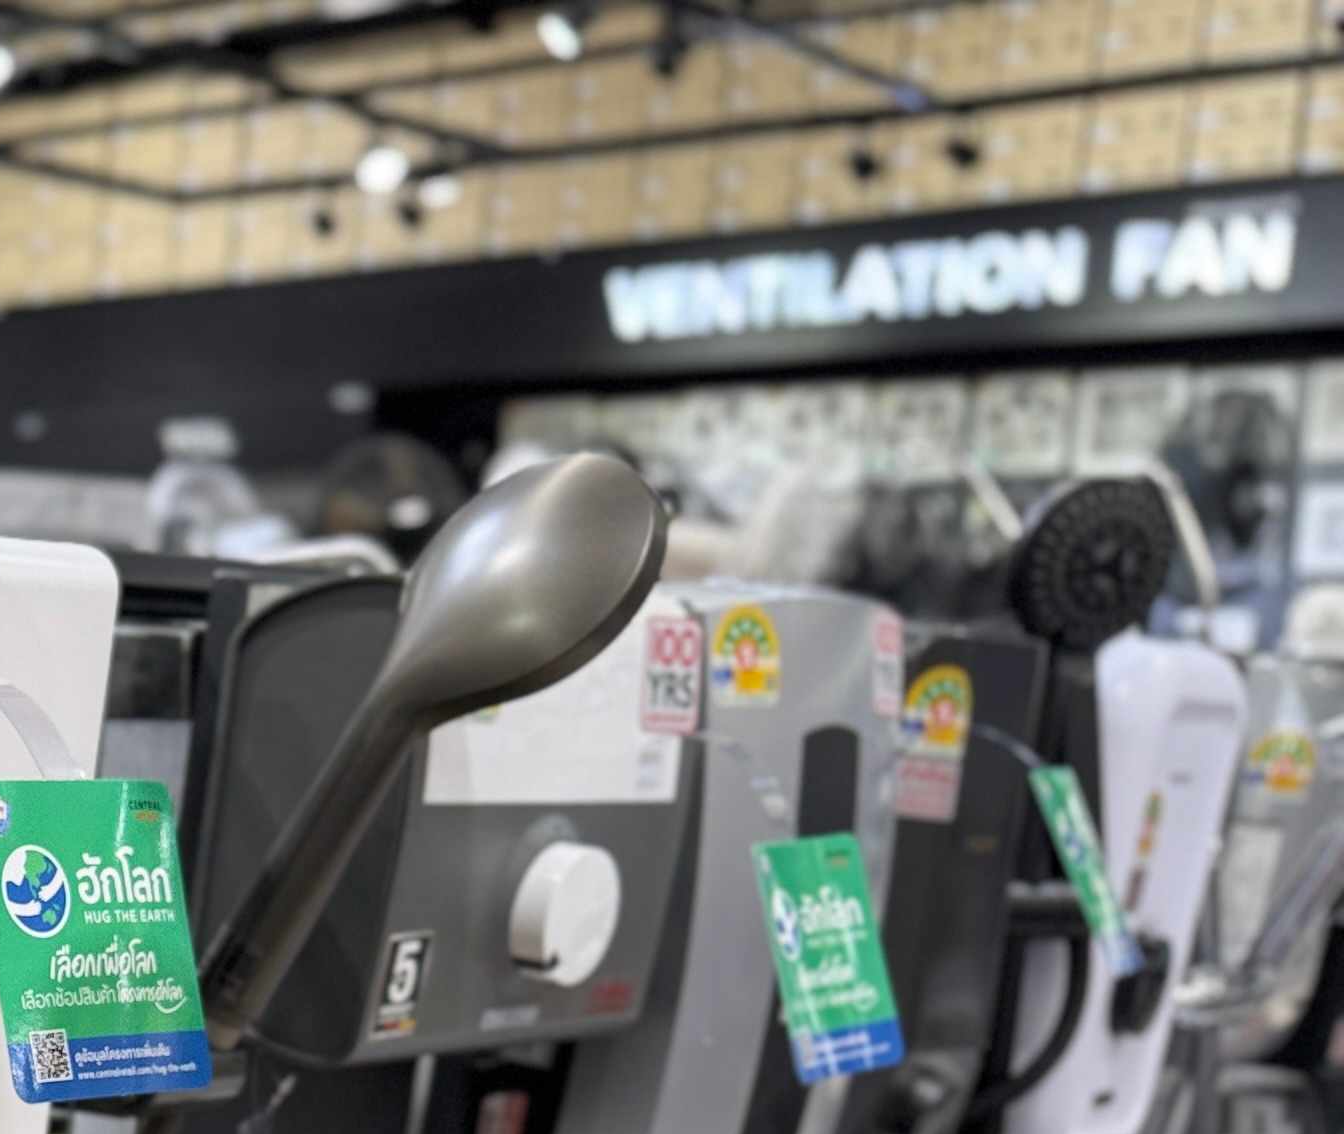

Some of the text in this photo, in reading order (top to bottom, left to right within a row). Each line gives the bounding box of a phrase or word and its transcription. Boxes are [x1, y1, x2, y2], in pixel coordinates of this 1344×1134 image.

[603, 207, 1296, 342] VENTILATION FAN
[76, 845, 173, 904] ฮักโลก
[84, 909, 176, 925] HUG THE EARTH
[387, 938, 423, 1004] 5
